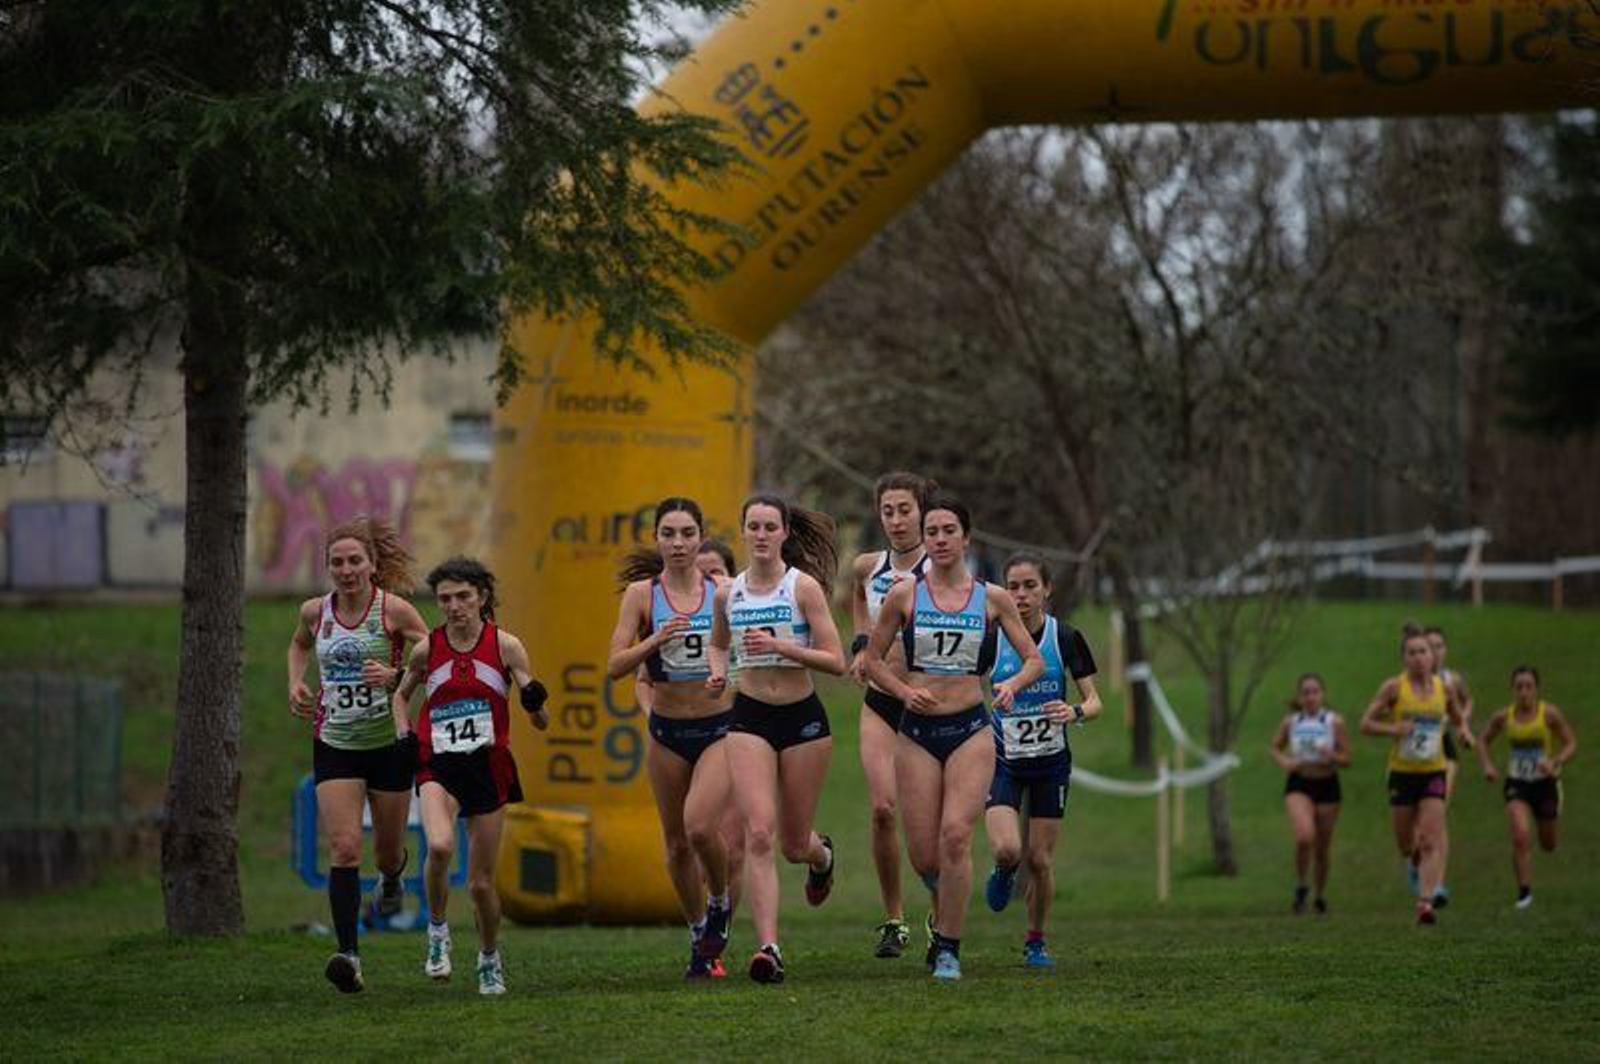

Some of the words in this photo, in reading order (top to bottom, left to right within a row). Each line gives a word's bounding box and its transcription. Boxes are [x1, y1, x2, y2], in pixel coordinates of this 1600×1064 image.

[712, 65, 930, 273] DPUTACIÓN
[771, 121, 922, 272] OURENSE
[685, 633, 702, 658] 9
[933, 631, 963, 656] 17
[337, 684, 372, 708] 33
[445, 718, 480, 744] 14
[546, 662, 597, 784] Plan
[1017, 717, 1053, 745] 22
